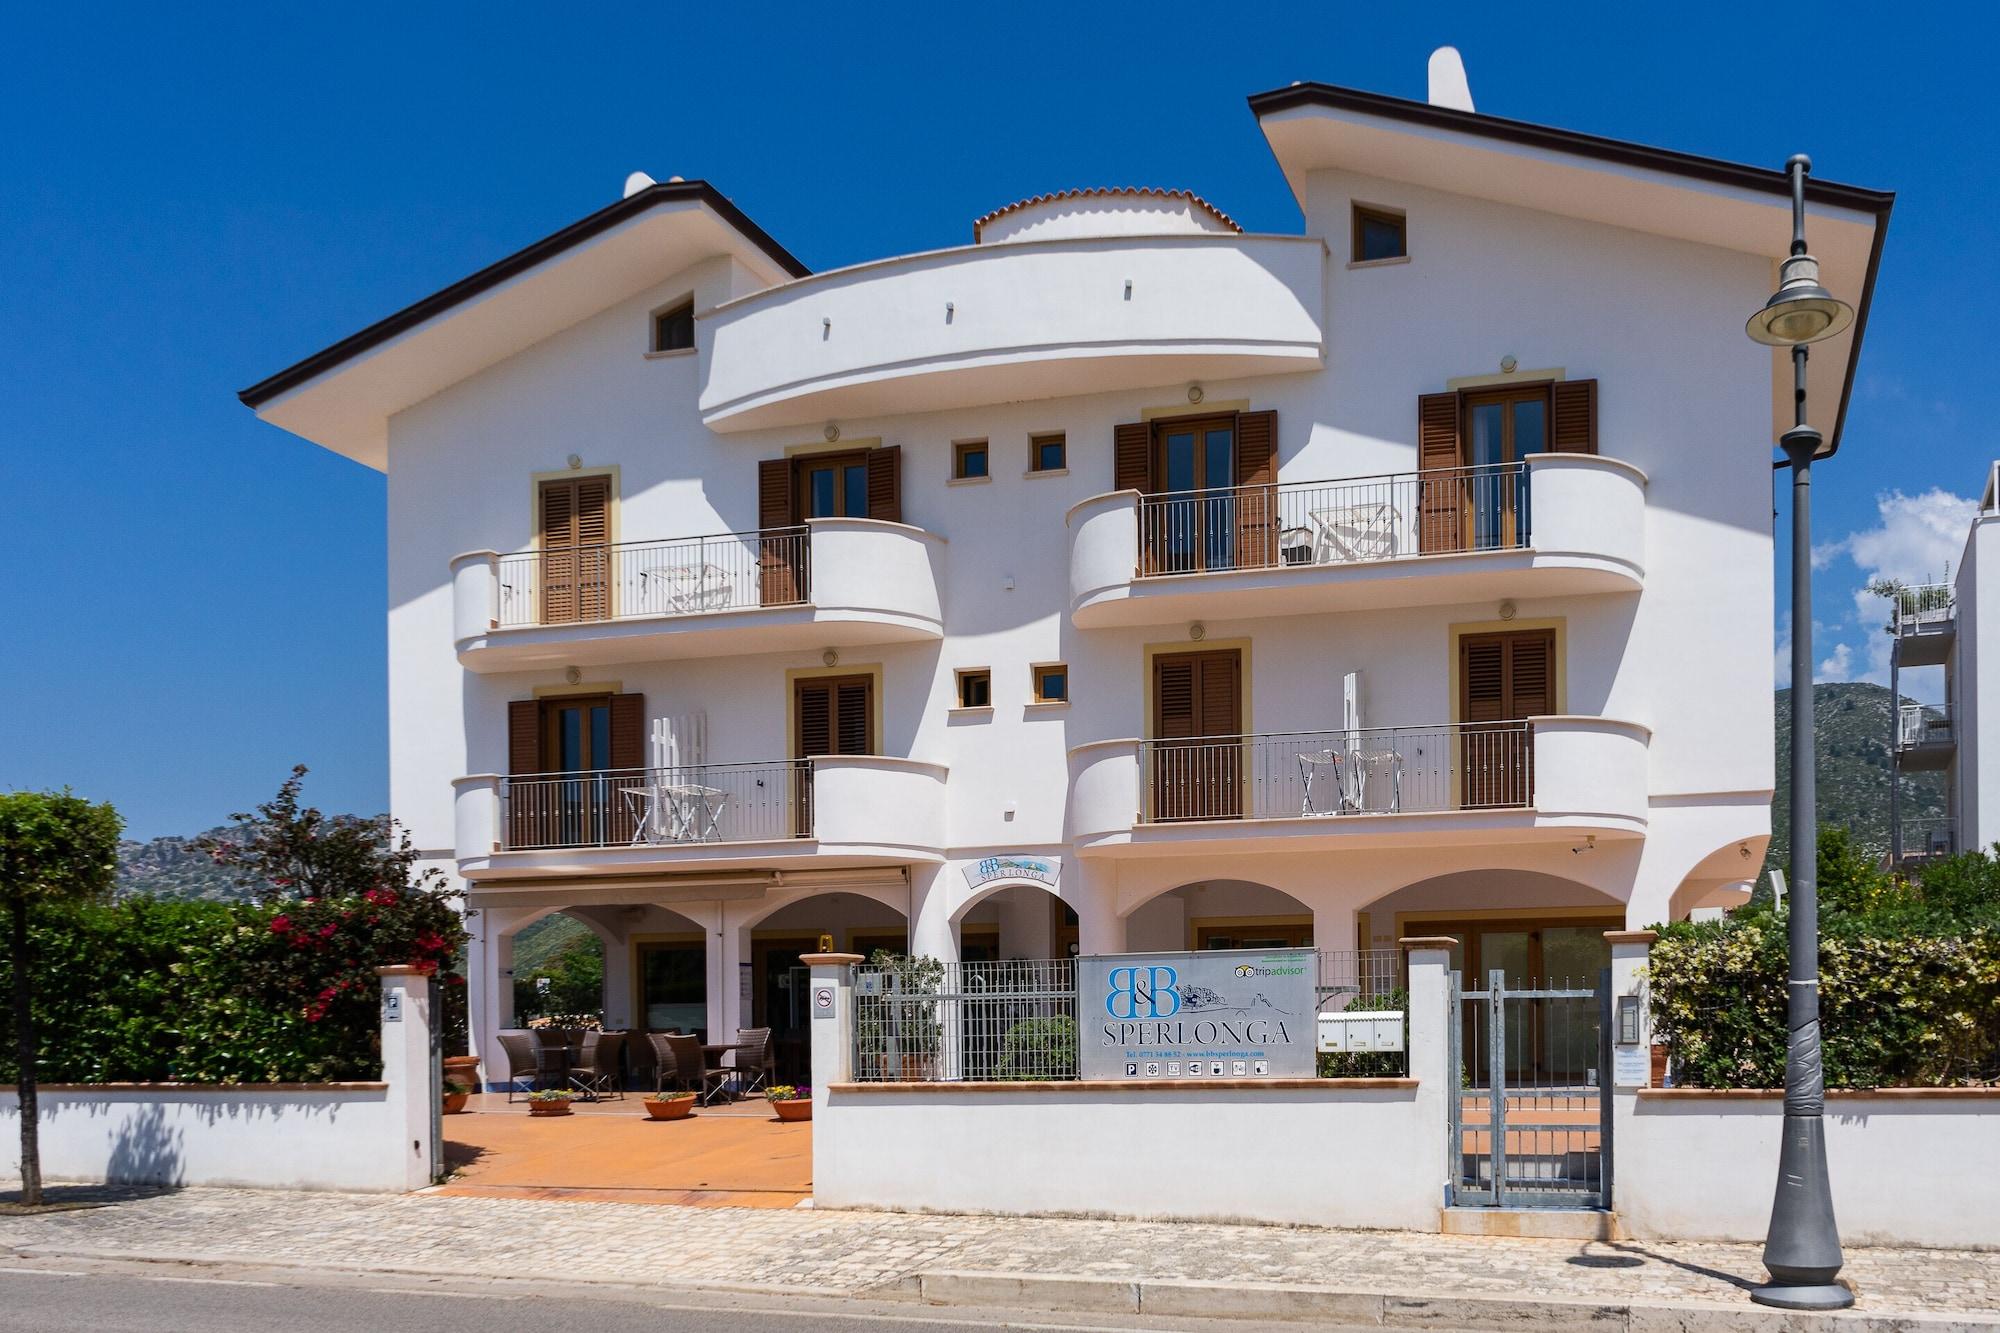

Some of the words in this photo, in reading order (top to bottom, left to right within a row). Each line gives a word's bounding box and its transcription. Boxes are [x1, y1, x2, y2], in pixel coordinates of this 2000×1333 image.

[981, 868, 1046, 881] SPERLONGA
[1255, 966, 1304, 978] tripadvisor
[1105, 965, 1181, 1019] B&B
[1103, 1020, 1293, 1047] SPERLONGA
[1186, 1050, 1265, 1058] www.bbsperlonga.com
